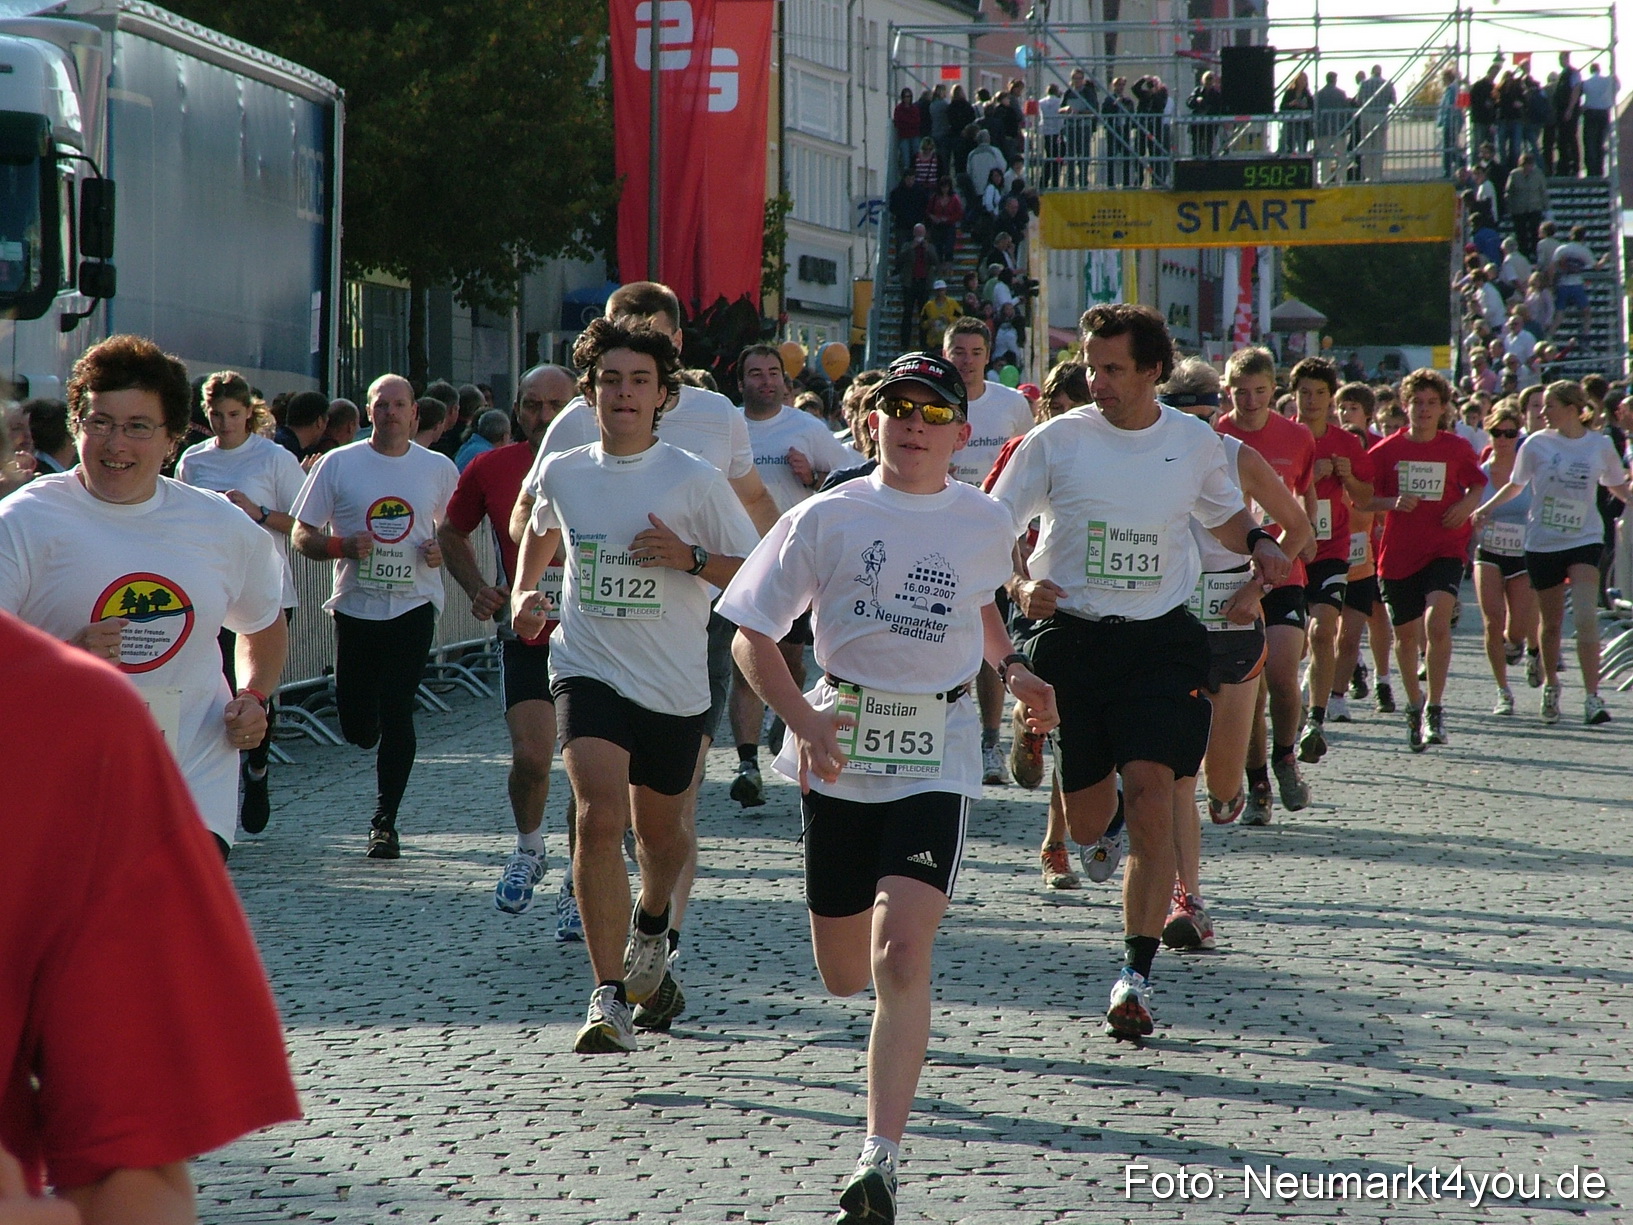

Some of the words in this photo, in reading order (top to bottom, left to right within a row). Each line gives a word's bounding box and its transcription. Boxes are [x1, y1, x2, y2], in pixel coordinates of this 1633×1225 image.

[1176, 198, 1317, 234] START
[1411, 478, 1442, 491] 5017
[1554, 512, 1583, 525] 5141
[1109, 527, 1159, 546] Wolfgang
[1494, 535, 1522, 549] 5110
[375, 547, 404, 558] Markus
[375, 563, 412, 579] 5012
[1109, 552, 1160, 573] 5131
[600, 576, 656, 599] 5122
[903, 581, 956, 600] 16.09.2007
[853, 599, 871, 618] 8.
[874, 607, 949, 632] Neumarkter
[144, 628, 165, 636] Freunde
[889, 623, 946, 644] Stadtlauf
[865, 696, 918, 717] Bastian
[863, 728, 935, 756] 5153
[898, 764, 940, 774] PFLEIDERER
[906, 855, 938, 868] adidas
